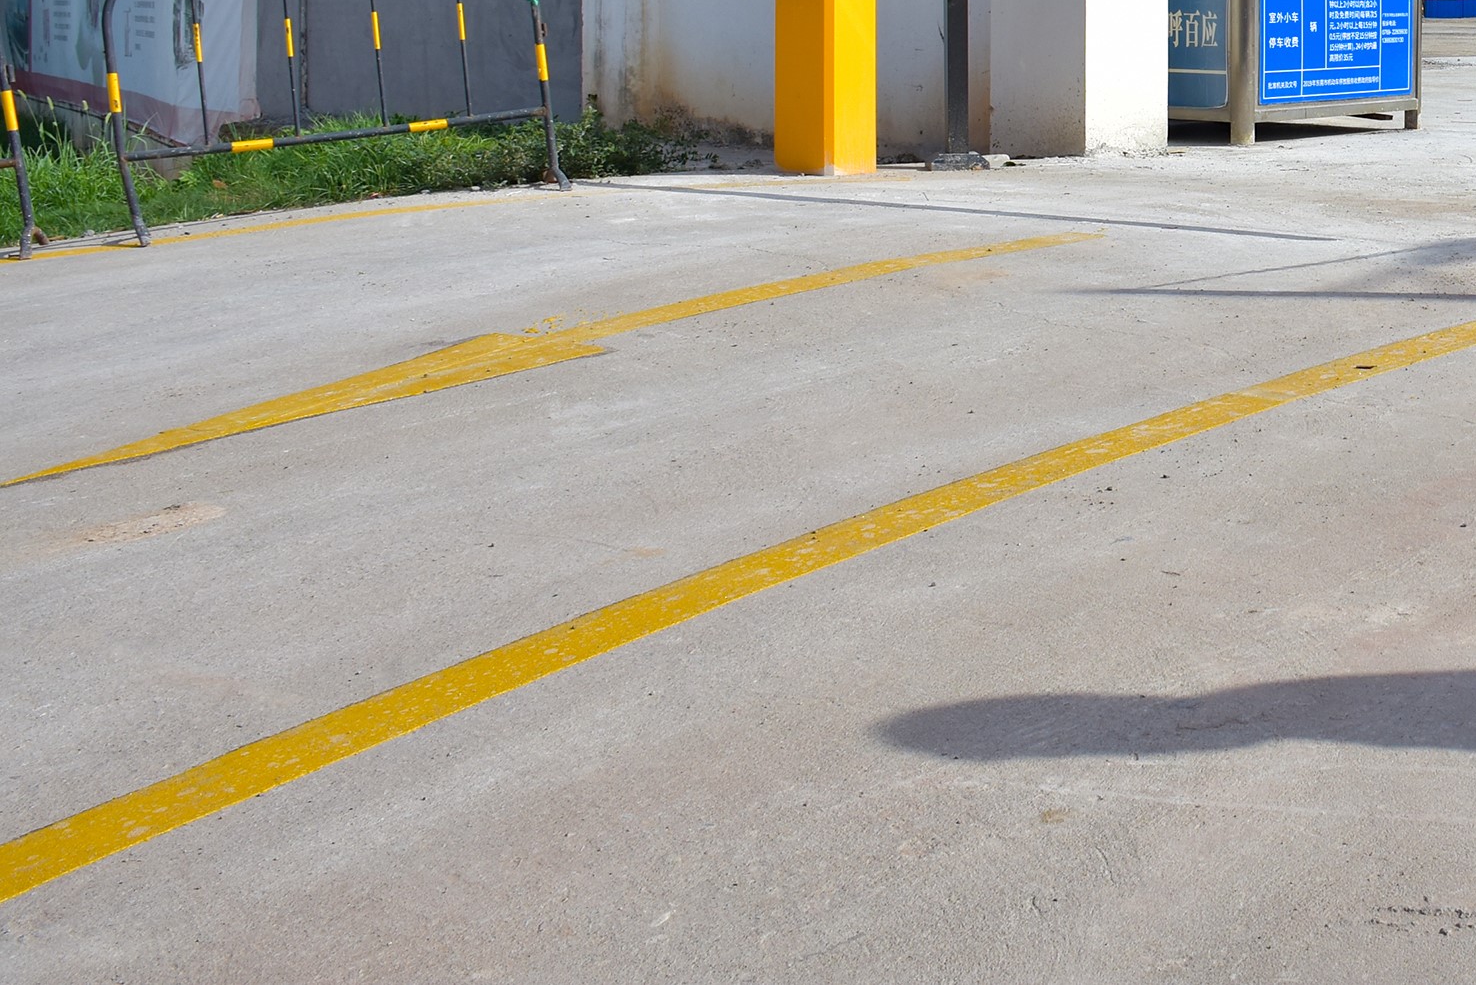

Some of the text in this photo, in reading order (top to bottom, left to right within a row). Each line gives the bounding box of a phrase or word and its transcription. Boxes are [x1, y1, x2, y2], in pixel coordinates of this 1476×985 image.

[1268, 11, 1299, 24] 室外小车
[1309, 21, 1318, 33] 辆
[1268, 36, 1299, 49] 停车收费
